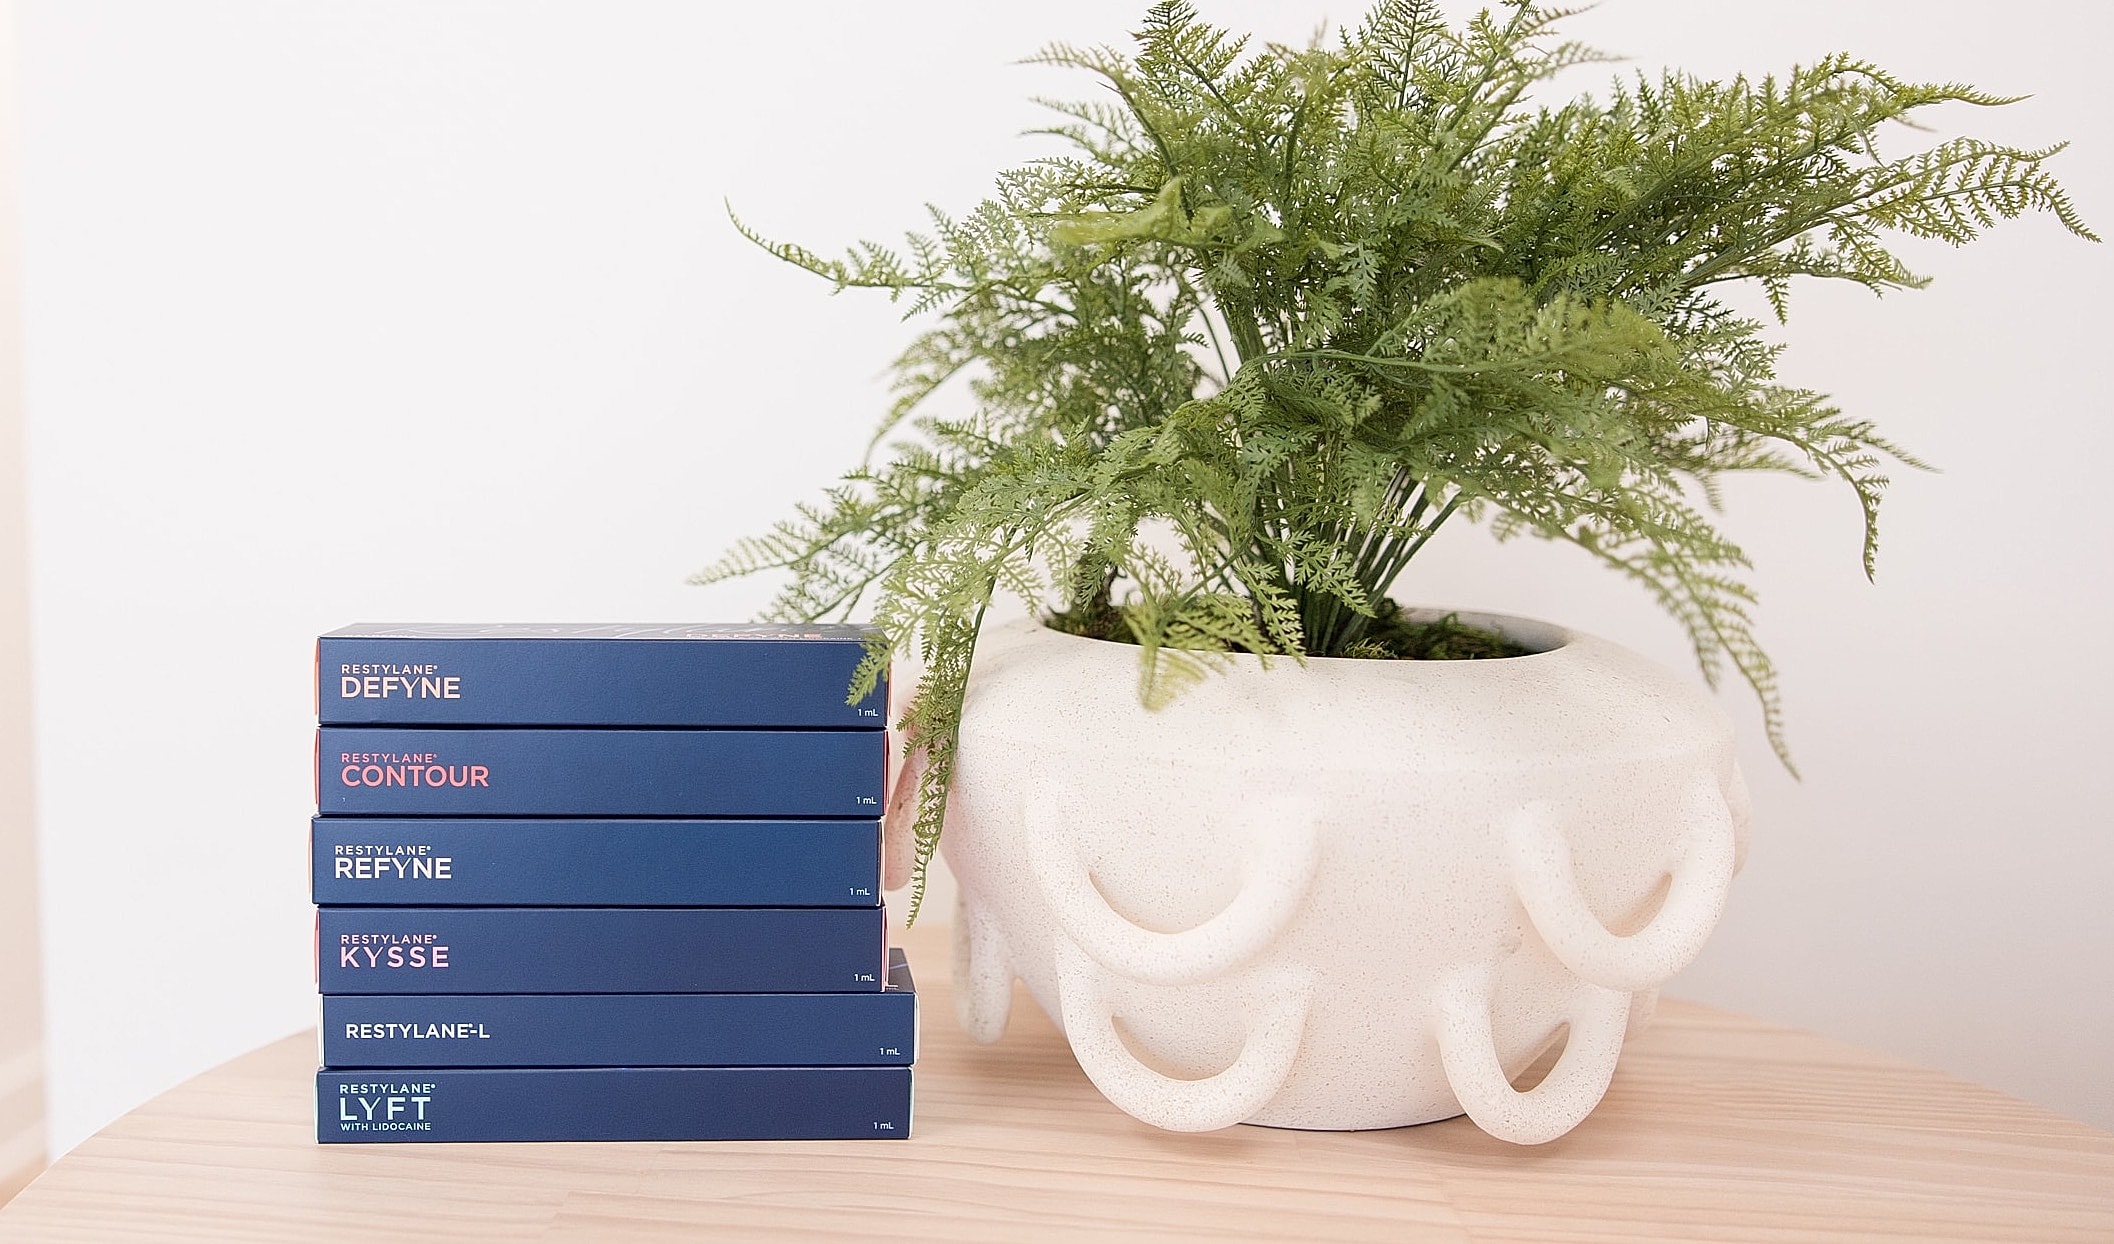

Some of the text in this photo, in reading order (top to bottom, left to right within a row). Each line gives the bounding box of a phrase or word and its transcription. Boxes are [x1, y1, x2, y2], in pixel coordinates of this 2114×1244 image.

[342, 676, 460, 699] DEFYNE
[864, 708, 878, 716] mL
[341, 764, 488, 787] CONTOUR
[863, 796, 876, 805] mL
[335, 857, 451, 879] REFYNE
[857, 887, 870, 896] mL
[341, 946, 448, 968] KYSSE
[861, 973, 874, 982] mL
[887, 1047, 900, 1056] mL
[340, 1097, 430, 1121] LYFT
[341, 1122, 431, 1132] WITH LIDOCAINE
[880, 1121, 893, 1130] mL
